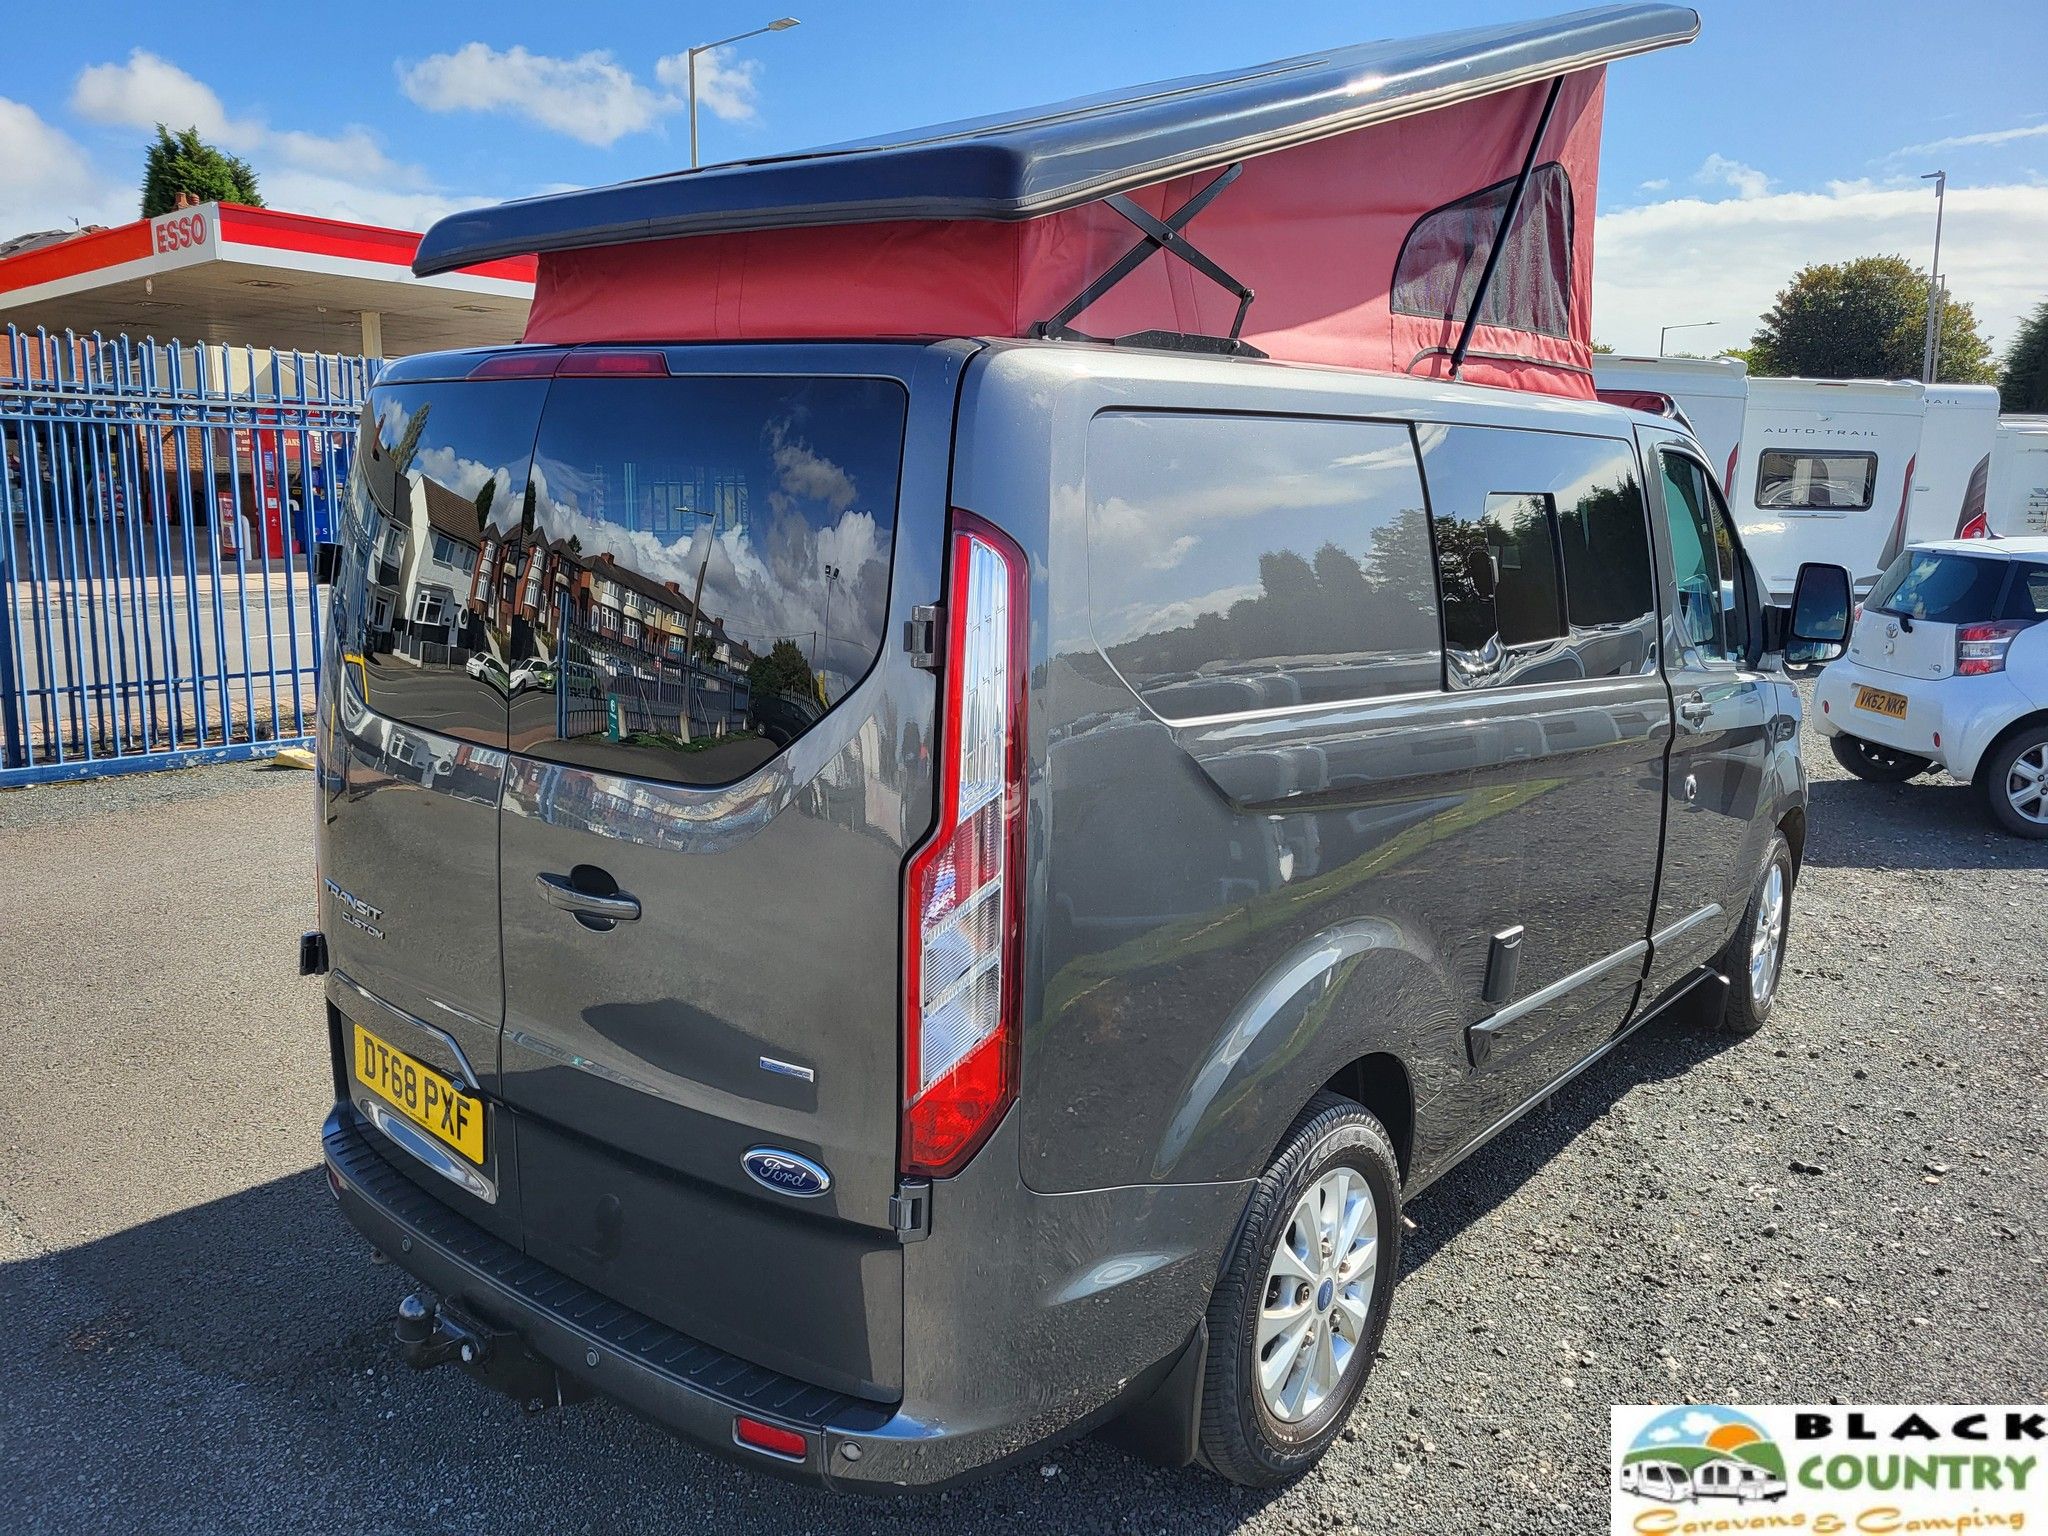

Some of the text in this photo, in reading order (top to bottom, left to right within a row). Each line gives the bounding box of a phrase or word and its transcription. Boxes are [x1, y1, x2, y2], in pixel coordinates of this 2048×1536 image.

[156, 213, 207, 254] ESSO
[1764, 427, 1879, 437] AUTO-TRAIL
[1860, 691, 1907, 716] VK62 NKR
[325, 878, 384, 920] TRANSIT
[342, 911, 385, 940] CUSTOM
[424, 1076, 470, 1142] PXF
[759, 1157, 806, 1188] Ford
